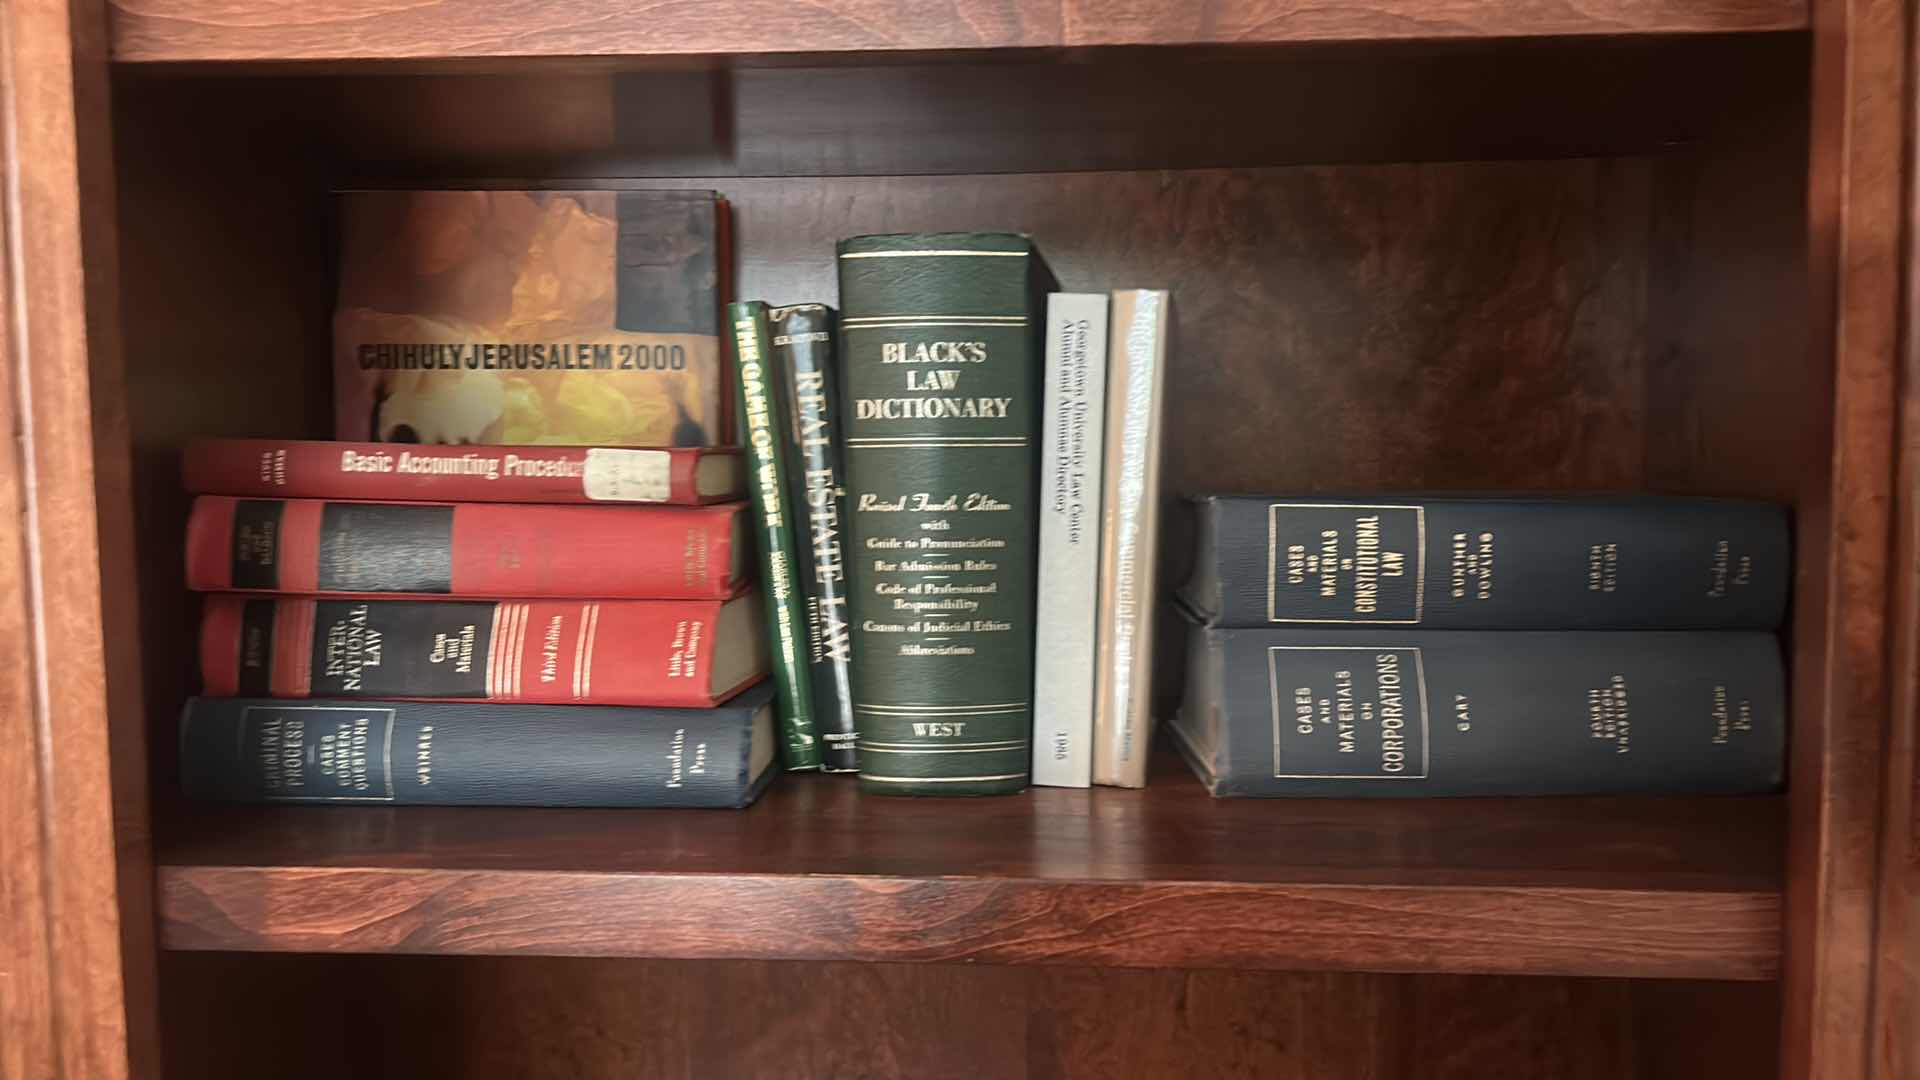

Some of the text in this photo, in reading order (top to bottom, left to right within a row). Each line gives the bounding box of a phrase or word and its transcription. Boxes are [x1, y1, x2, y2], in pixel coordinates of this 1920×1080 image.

[619, 344, 685, 370] 2000
[735, 317, 761, 362] THE
[880, 341, 987, 364] BLACK'S
[1062, 320, 1075, 366] Alumni
[741, 362, 769, 428] GAME
[905, 370, 960, 391] LAW
[1060, 369, 1074, 392] and
[796, 369, 830, 456] REAL
[855, 397, 1013, 419] DICTIONARY
[751, 431, 774, 460] OF
[1069, 320, 1090, 544] Georgetown University Law Center
[341, 448, 393, 476] Basic
[397, 452, 499, 480] Accounting
[1053, 456, 1071, 514] Directory
[806, 468, 843, 583] ESTATE
[865, 537, 902, 549] Guide
[905, 539, 918, 549] to
[920, 520, 950, 530] with
[1288, 545, 1304, 583] CASES
[1307, 555, 1319, 572] AND
[1321, 530, 1338, 596] MATERIALS
[1341, 559, 1352, 570] ON
[1354, 516, 1379, 612] CONSTITUTIONAL
[1381, 552, 1404, 576] LAW
[1478, 532, 1494, 599] DOWLING
[875, 582, 997, 594] Code of Professional
[344, 605, 368, 691] NATIONAL
[364, 630, 382, 666] LAW
[445, 639, 460, 658] and
[456, 625, 475, 673] Materials
[809, 625, 823, 663] EDITION
[819, 596, 851, 662] LAW
[912, 722, 967, 737] WEST
[1295, 688, 1313, 734] CASES
[1320, 699, 1331, 723] AND
[1335, 670, 1354, 752] MATERIALS
[1361, 703, 1373, 720] ON
[1376, 654, 1404, 771] CORPORATIONS
[260, 718, 282, 789] CRIMINAL
[284, 721, 304, 786] PROCESS
[321, 735, 335, 775] CASES
[336, 723, 352, 785] COMMENT
[353, 719, 369, 790] QUESTIONS
[665, 729, 685, 788] Foundation
[689, 744, 706, 774] Press
